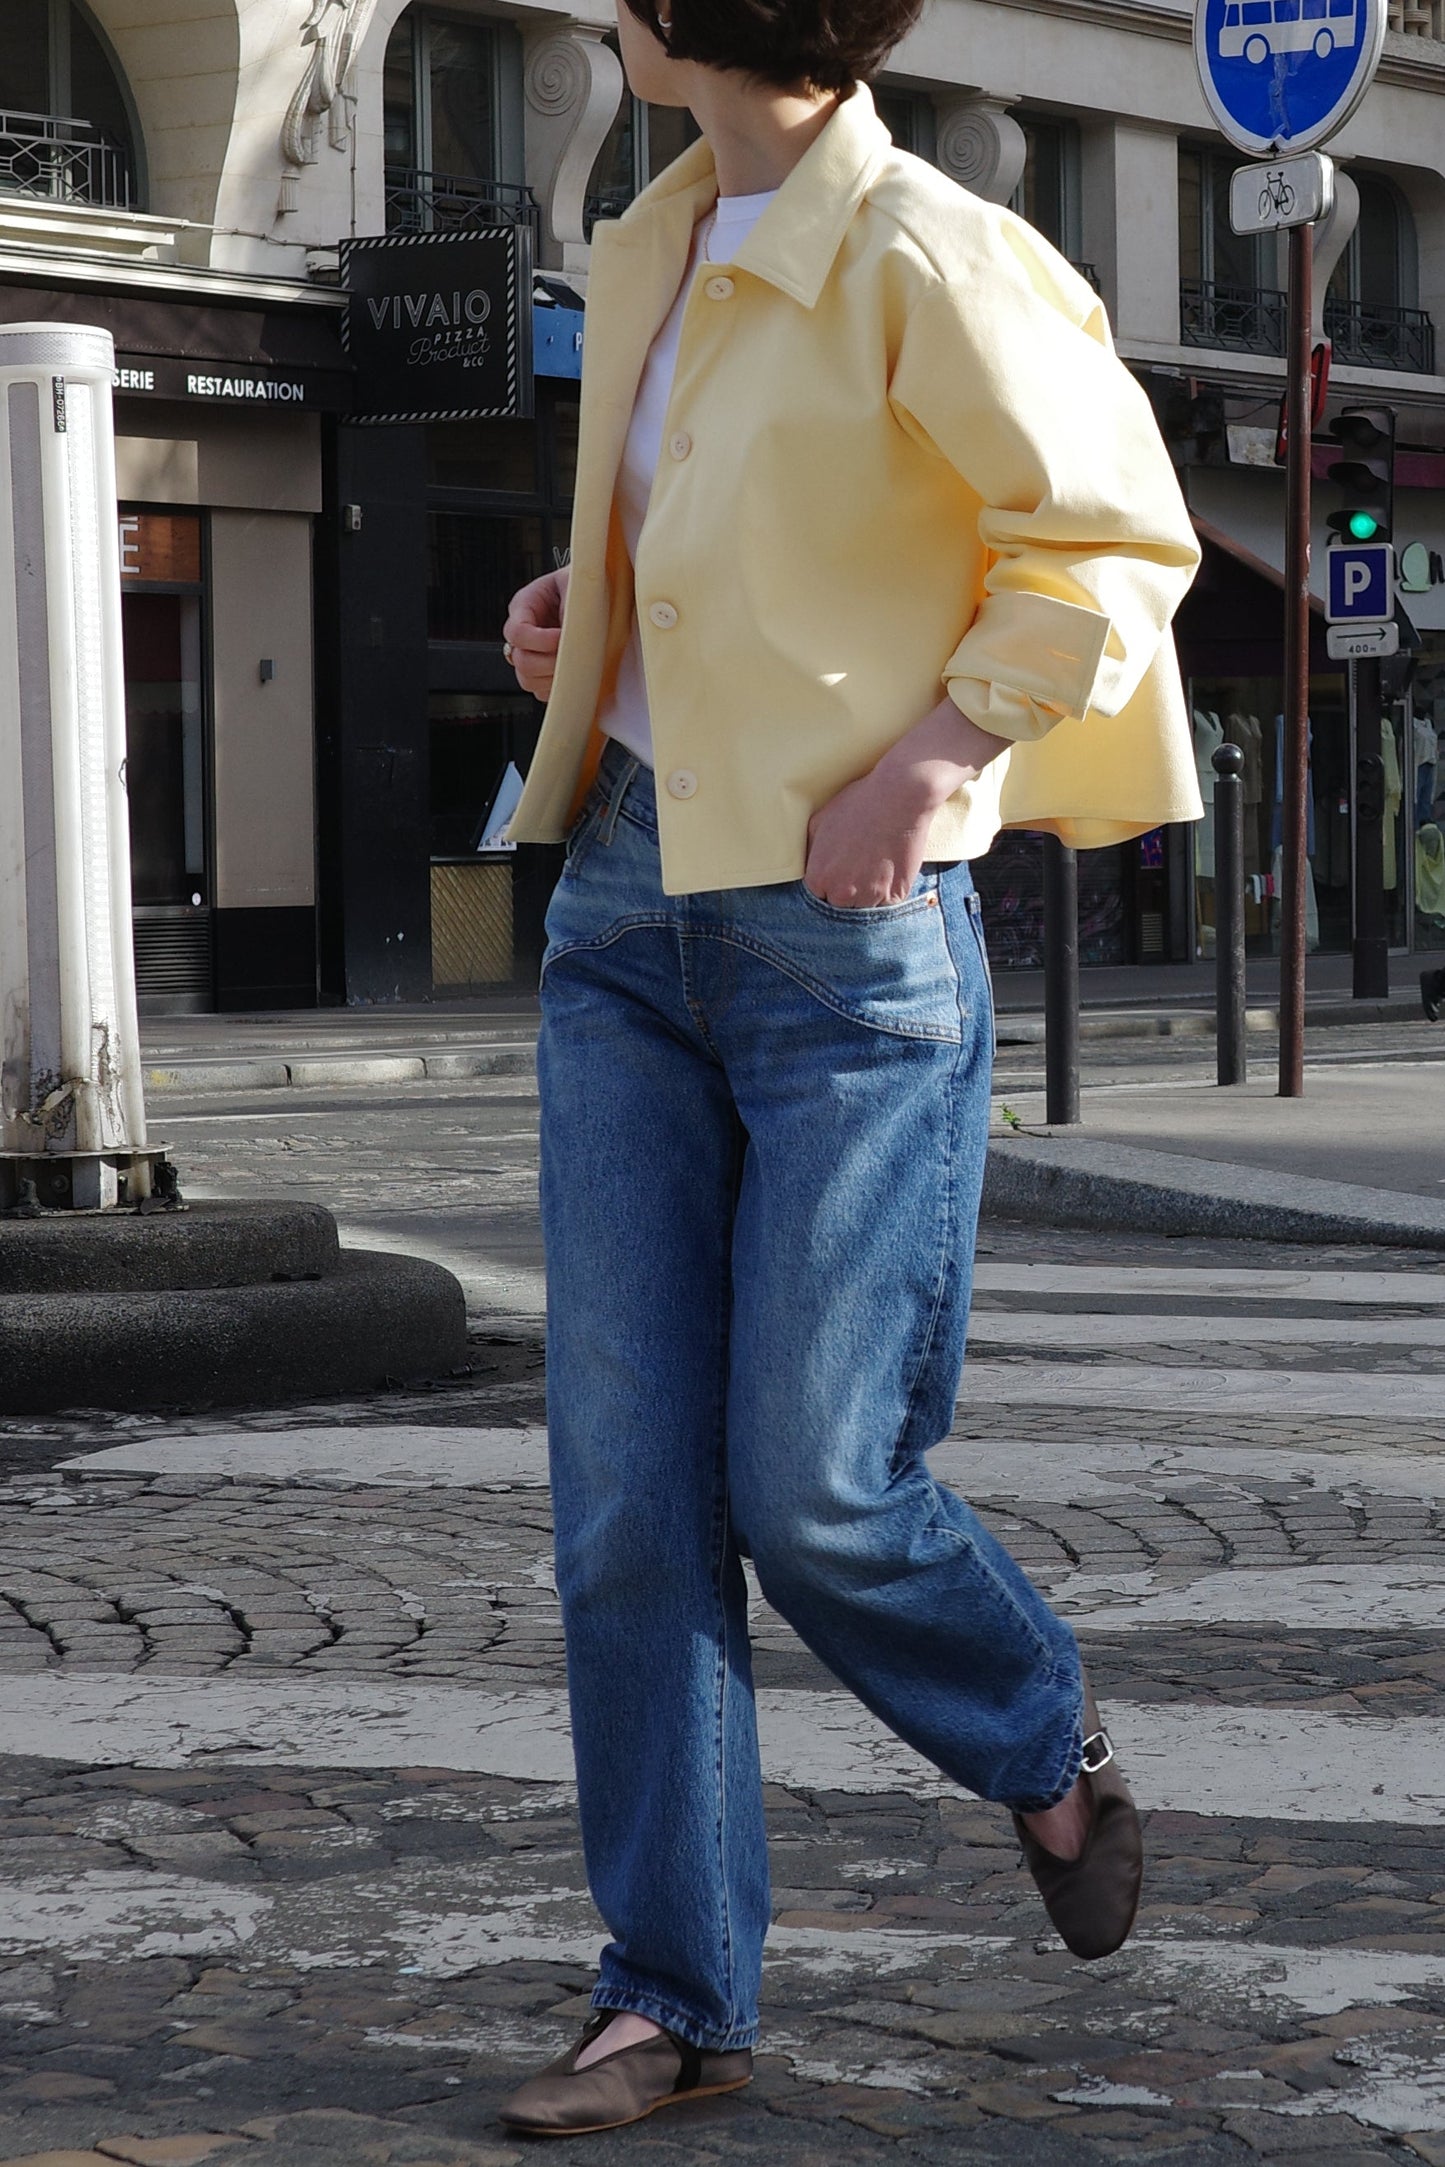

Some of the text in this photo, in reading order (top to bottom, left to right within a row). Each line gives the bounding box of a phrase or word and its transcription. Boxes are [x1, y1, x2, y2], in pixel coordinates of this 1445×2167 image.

[367, 289, 491, 330] VIVAIO
[407, 334, 491, 366] Product
[434, 326, 485, 345] PIZZA
[463, 356, 485, 368] &CO
[188, 374, 305, 401] RESTAURATION
[1344, 561, 1372, 606] P
